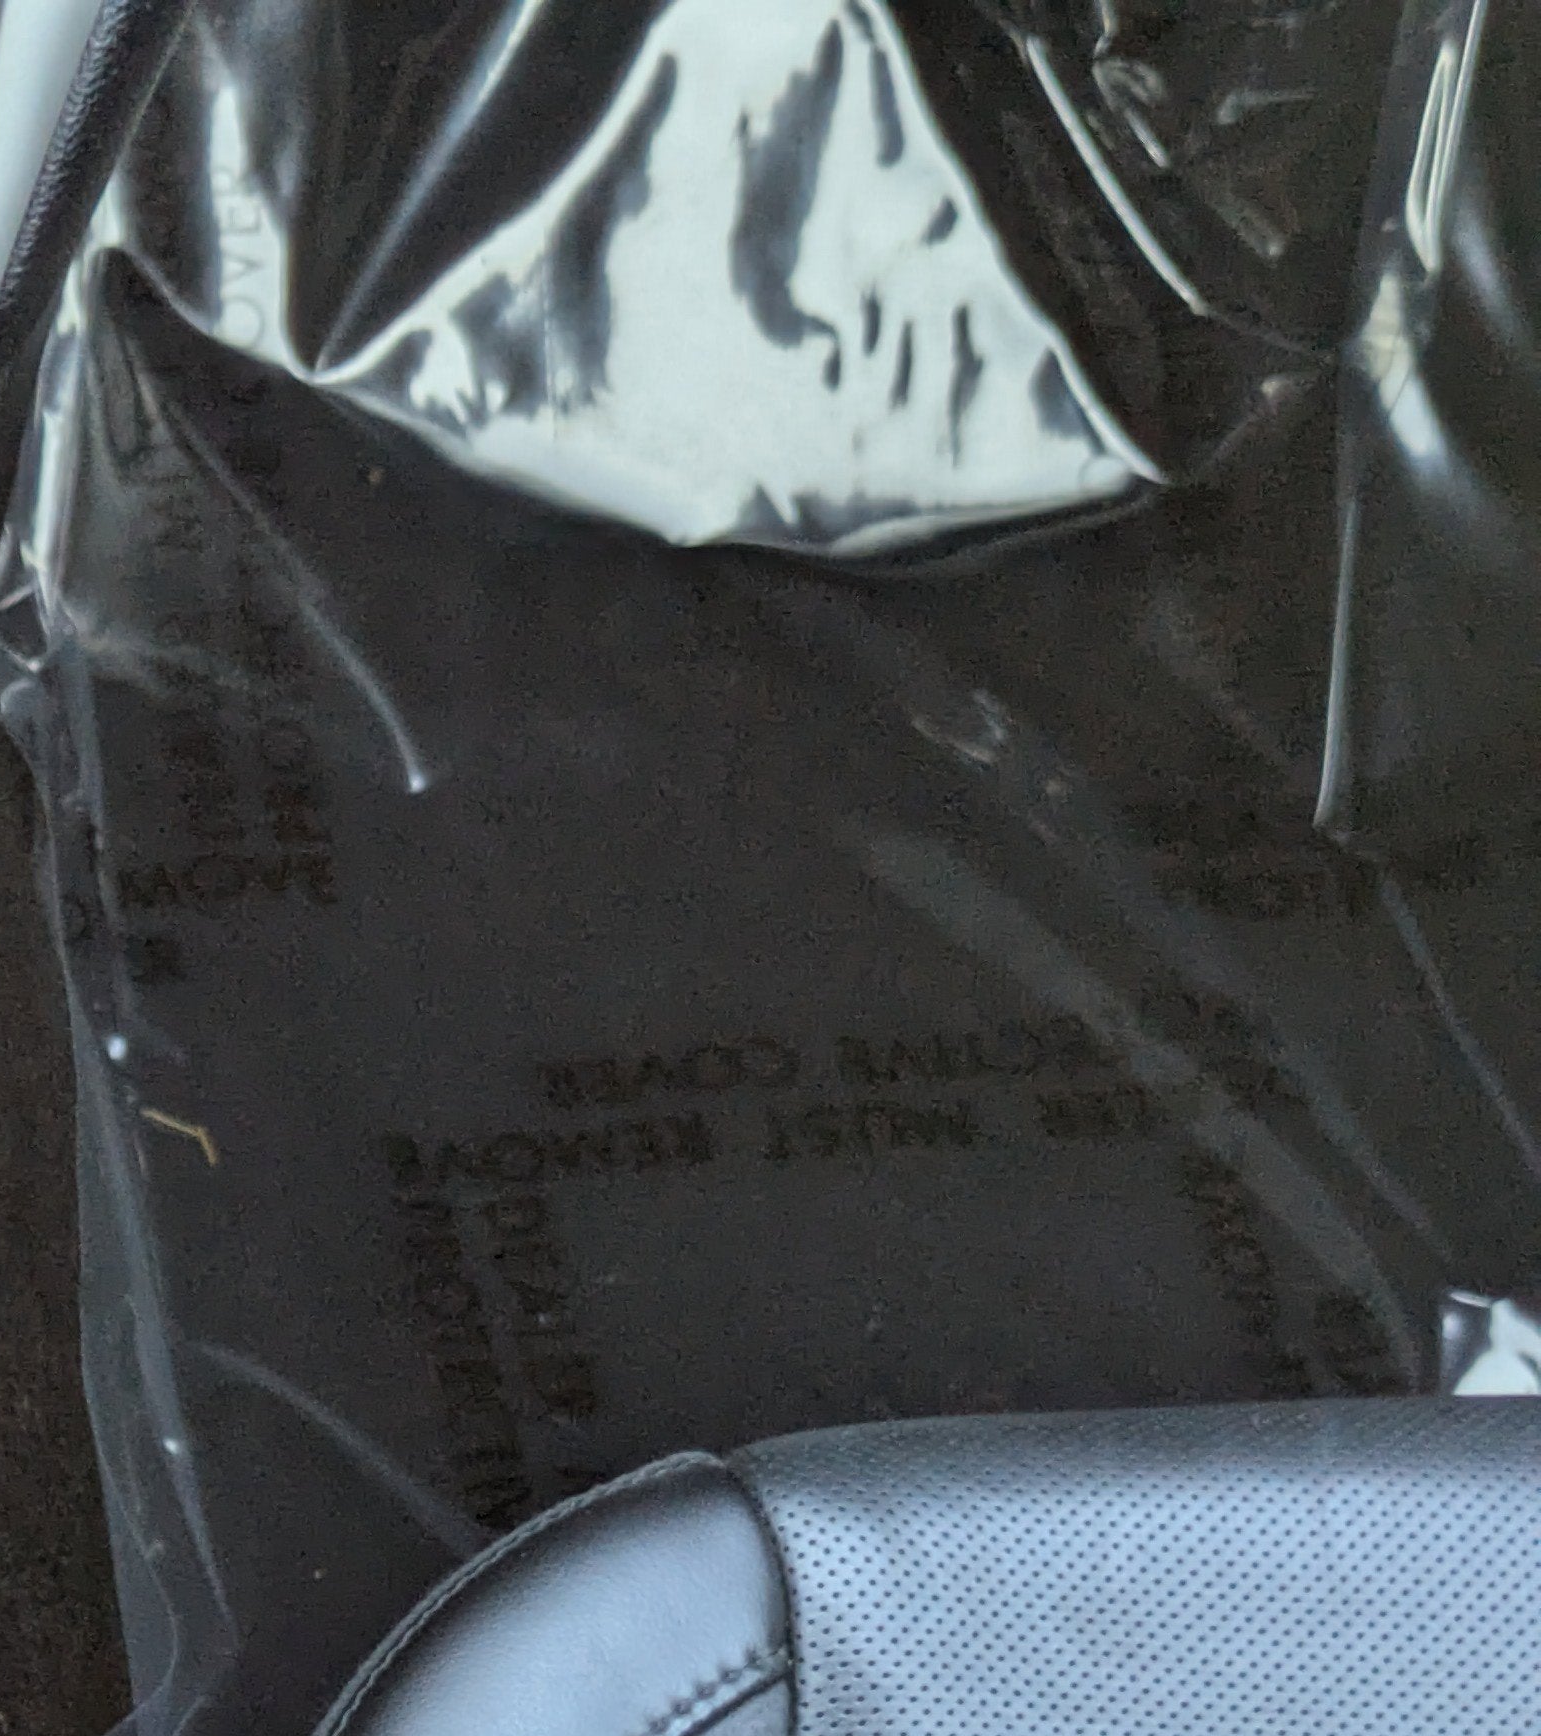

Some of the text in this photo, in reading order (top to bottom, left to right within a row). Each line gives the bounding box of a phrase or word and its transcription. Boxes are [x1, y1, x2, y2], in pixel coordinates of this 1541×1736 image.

[119, 855, 339, 905] MOVE
[539, 1035, 799, 1110] COVER
[379, 1110, 715, 1192] REMOVE
[762, 1100, 977, 1168] MUST
